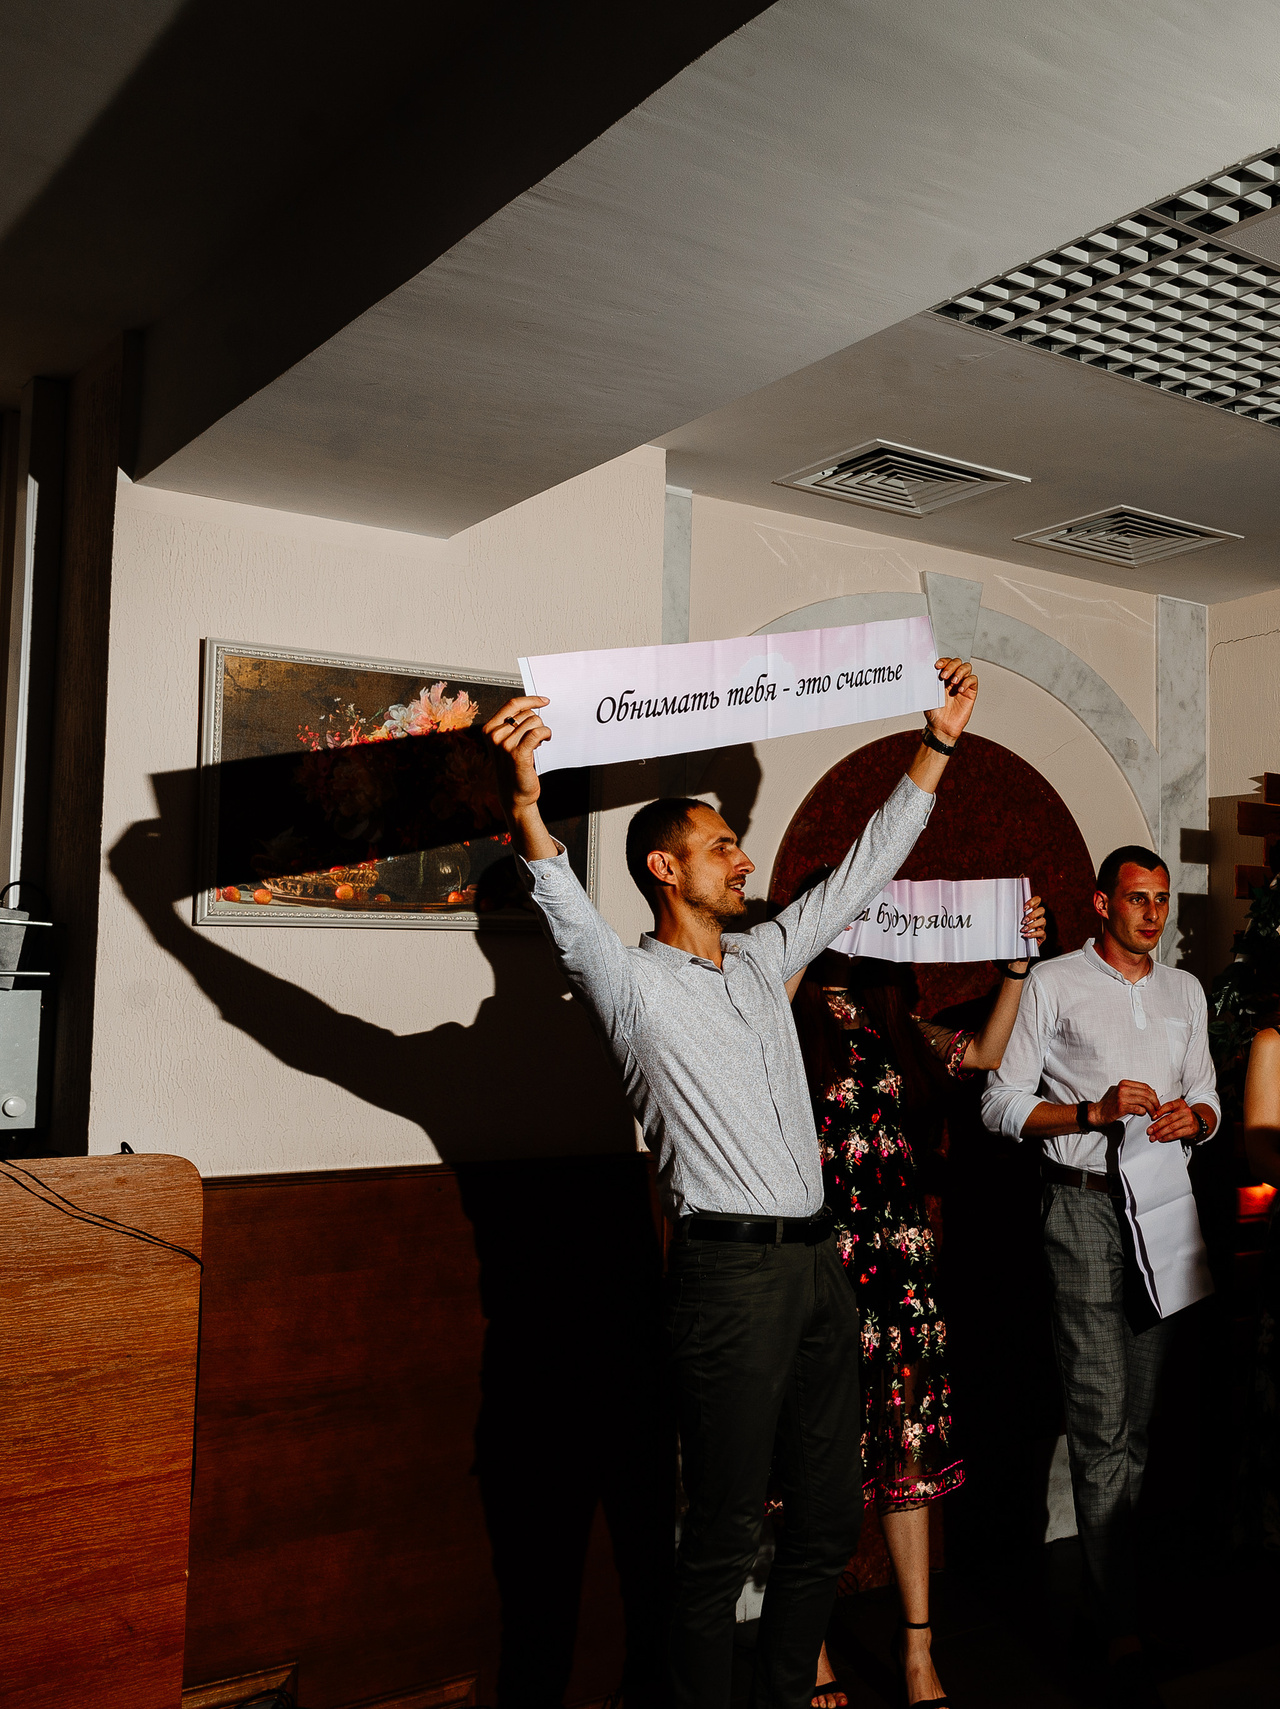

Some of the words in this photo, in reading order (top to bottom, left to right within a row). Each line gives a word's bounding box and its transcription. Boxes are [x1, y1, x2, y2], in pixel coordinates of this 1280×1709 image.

[596, 689, 720, 724] Обнимать
[727, 673, 777, 707] тебя
[795, 674, 831, 697] это
[836, 663, 903, 691] счастье
